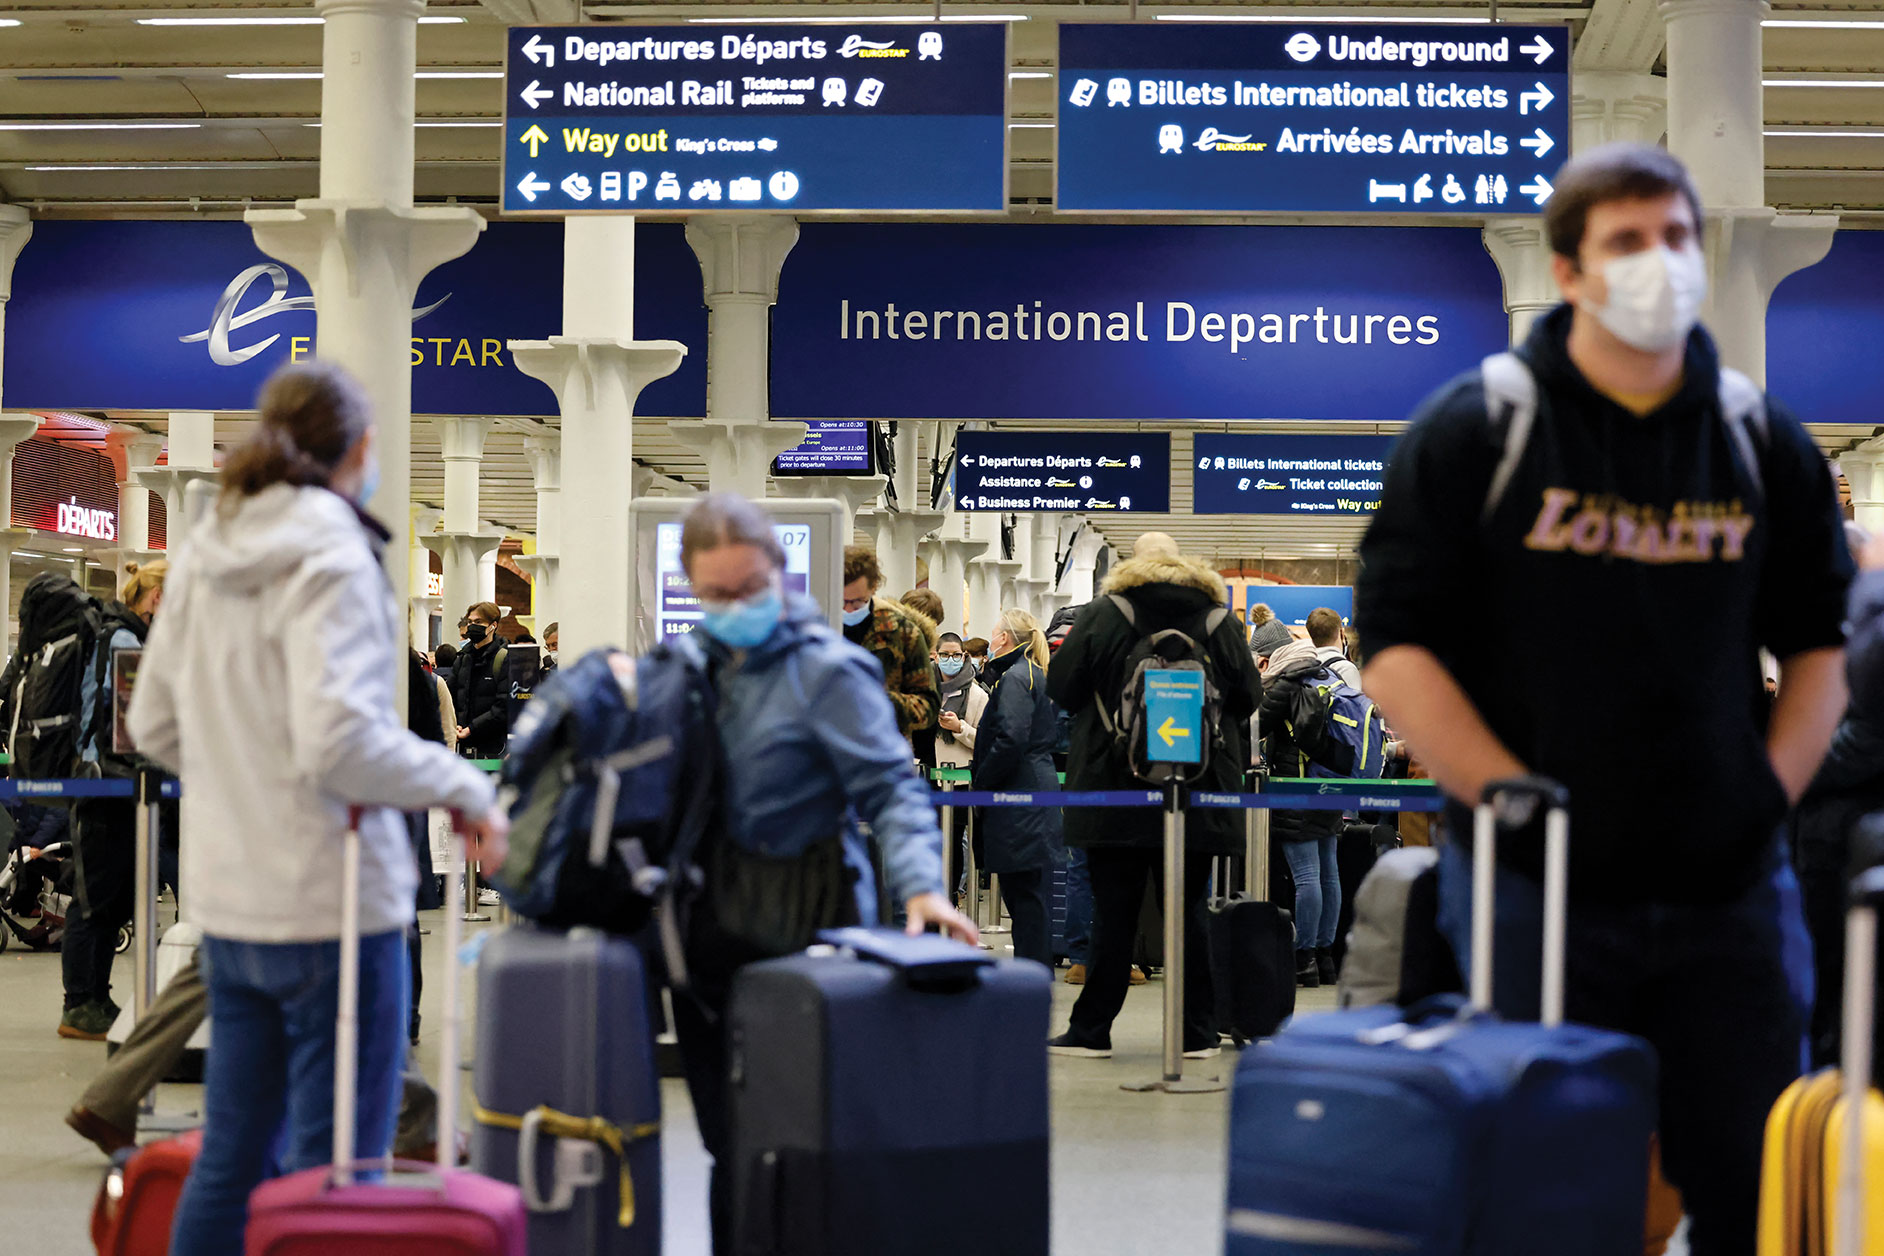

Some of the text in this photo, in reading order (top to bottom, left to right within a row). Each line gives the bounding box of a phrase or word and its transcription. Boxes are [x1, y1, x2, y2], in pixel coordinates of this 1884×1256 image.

[565, 36, 715, 66] Departures
[722, 34, 827, 65] Départs
[1329, 35, 1509, 67] Underground
[564, 80, 734, 106] National Rail
[742, 77, 815, 90] Tickets and
[742, 92, 805, 107] platforms
[1139, 80, 1509, 108] Billets International tickets
[563, 128, 755, 158] Way out King's Cross
[1276, 127, 1393, 153] Arrivées
[1398, 128, 1509, 155] Arrivals
[840, 300, 1440, 353] International Departures
[979, 454, 1092, 469] Departures Départs
[1228, 458, 1383, 471] Billets International tickets
[979, 475, 1041, 488] Assistance
[1290, 478, 1383, 491] Ticket collection
[979, 496, 1081, 509] Business Premier
[1337, 498, 1361, 512] Way
[58, 496, 114, 540] DÉPARTS
